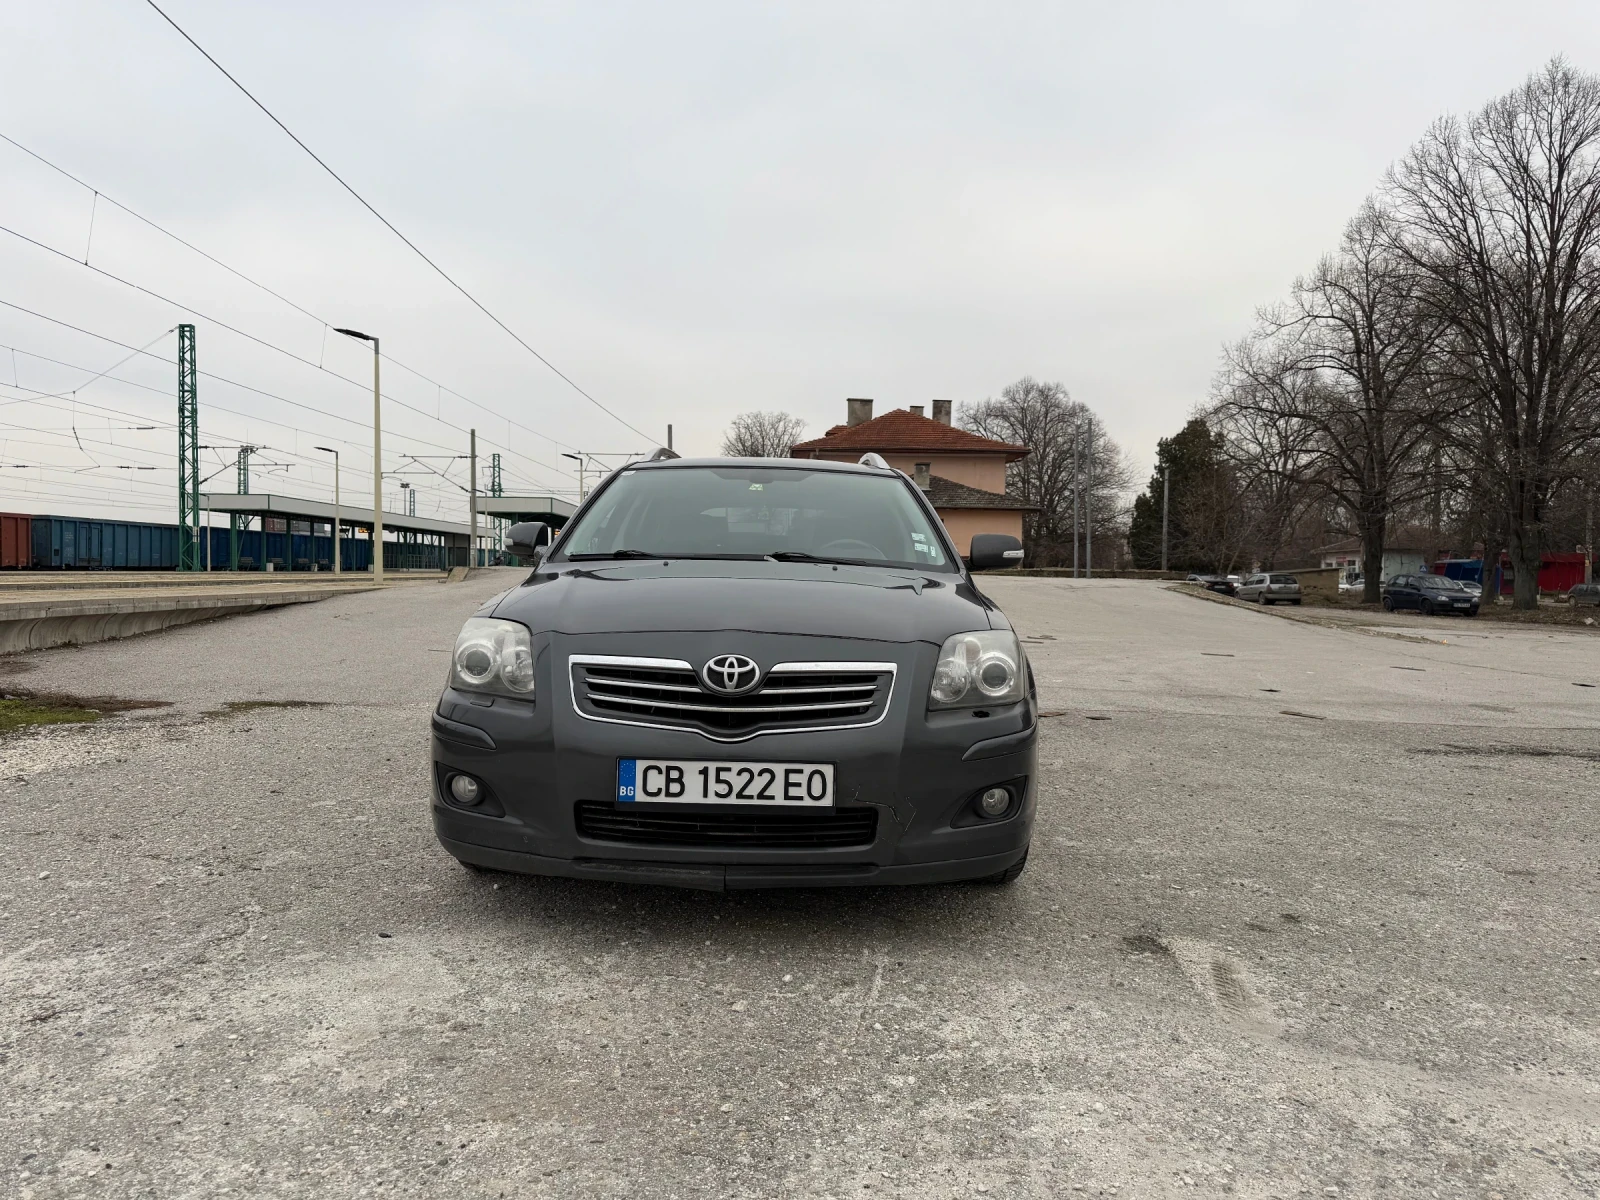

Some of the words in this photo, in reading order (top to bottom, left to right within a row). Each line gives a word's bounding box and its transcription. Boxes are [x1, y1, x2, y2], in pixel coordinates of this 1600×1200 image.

[619, 786, 634, 796] BG
[642, 765, 685, 798] CB
[698, 766, 776, 800] 1522
